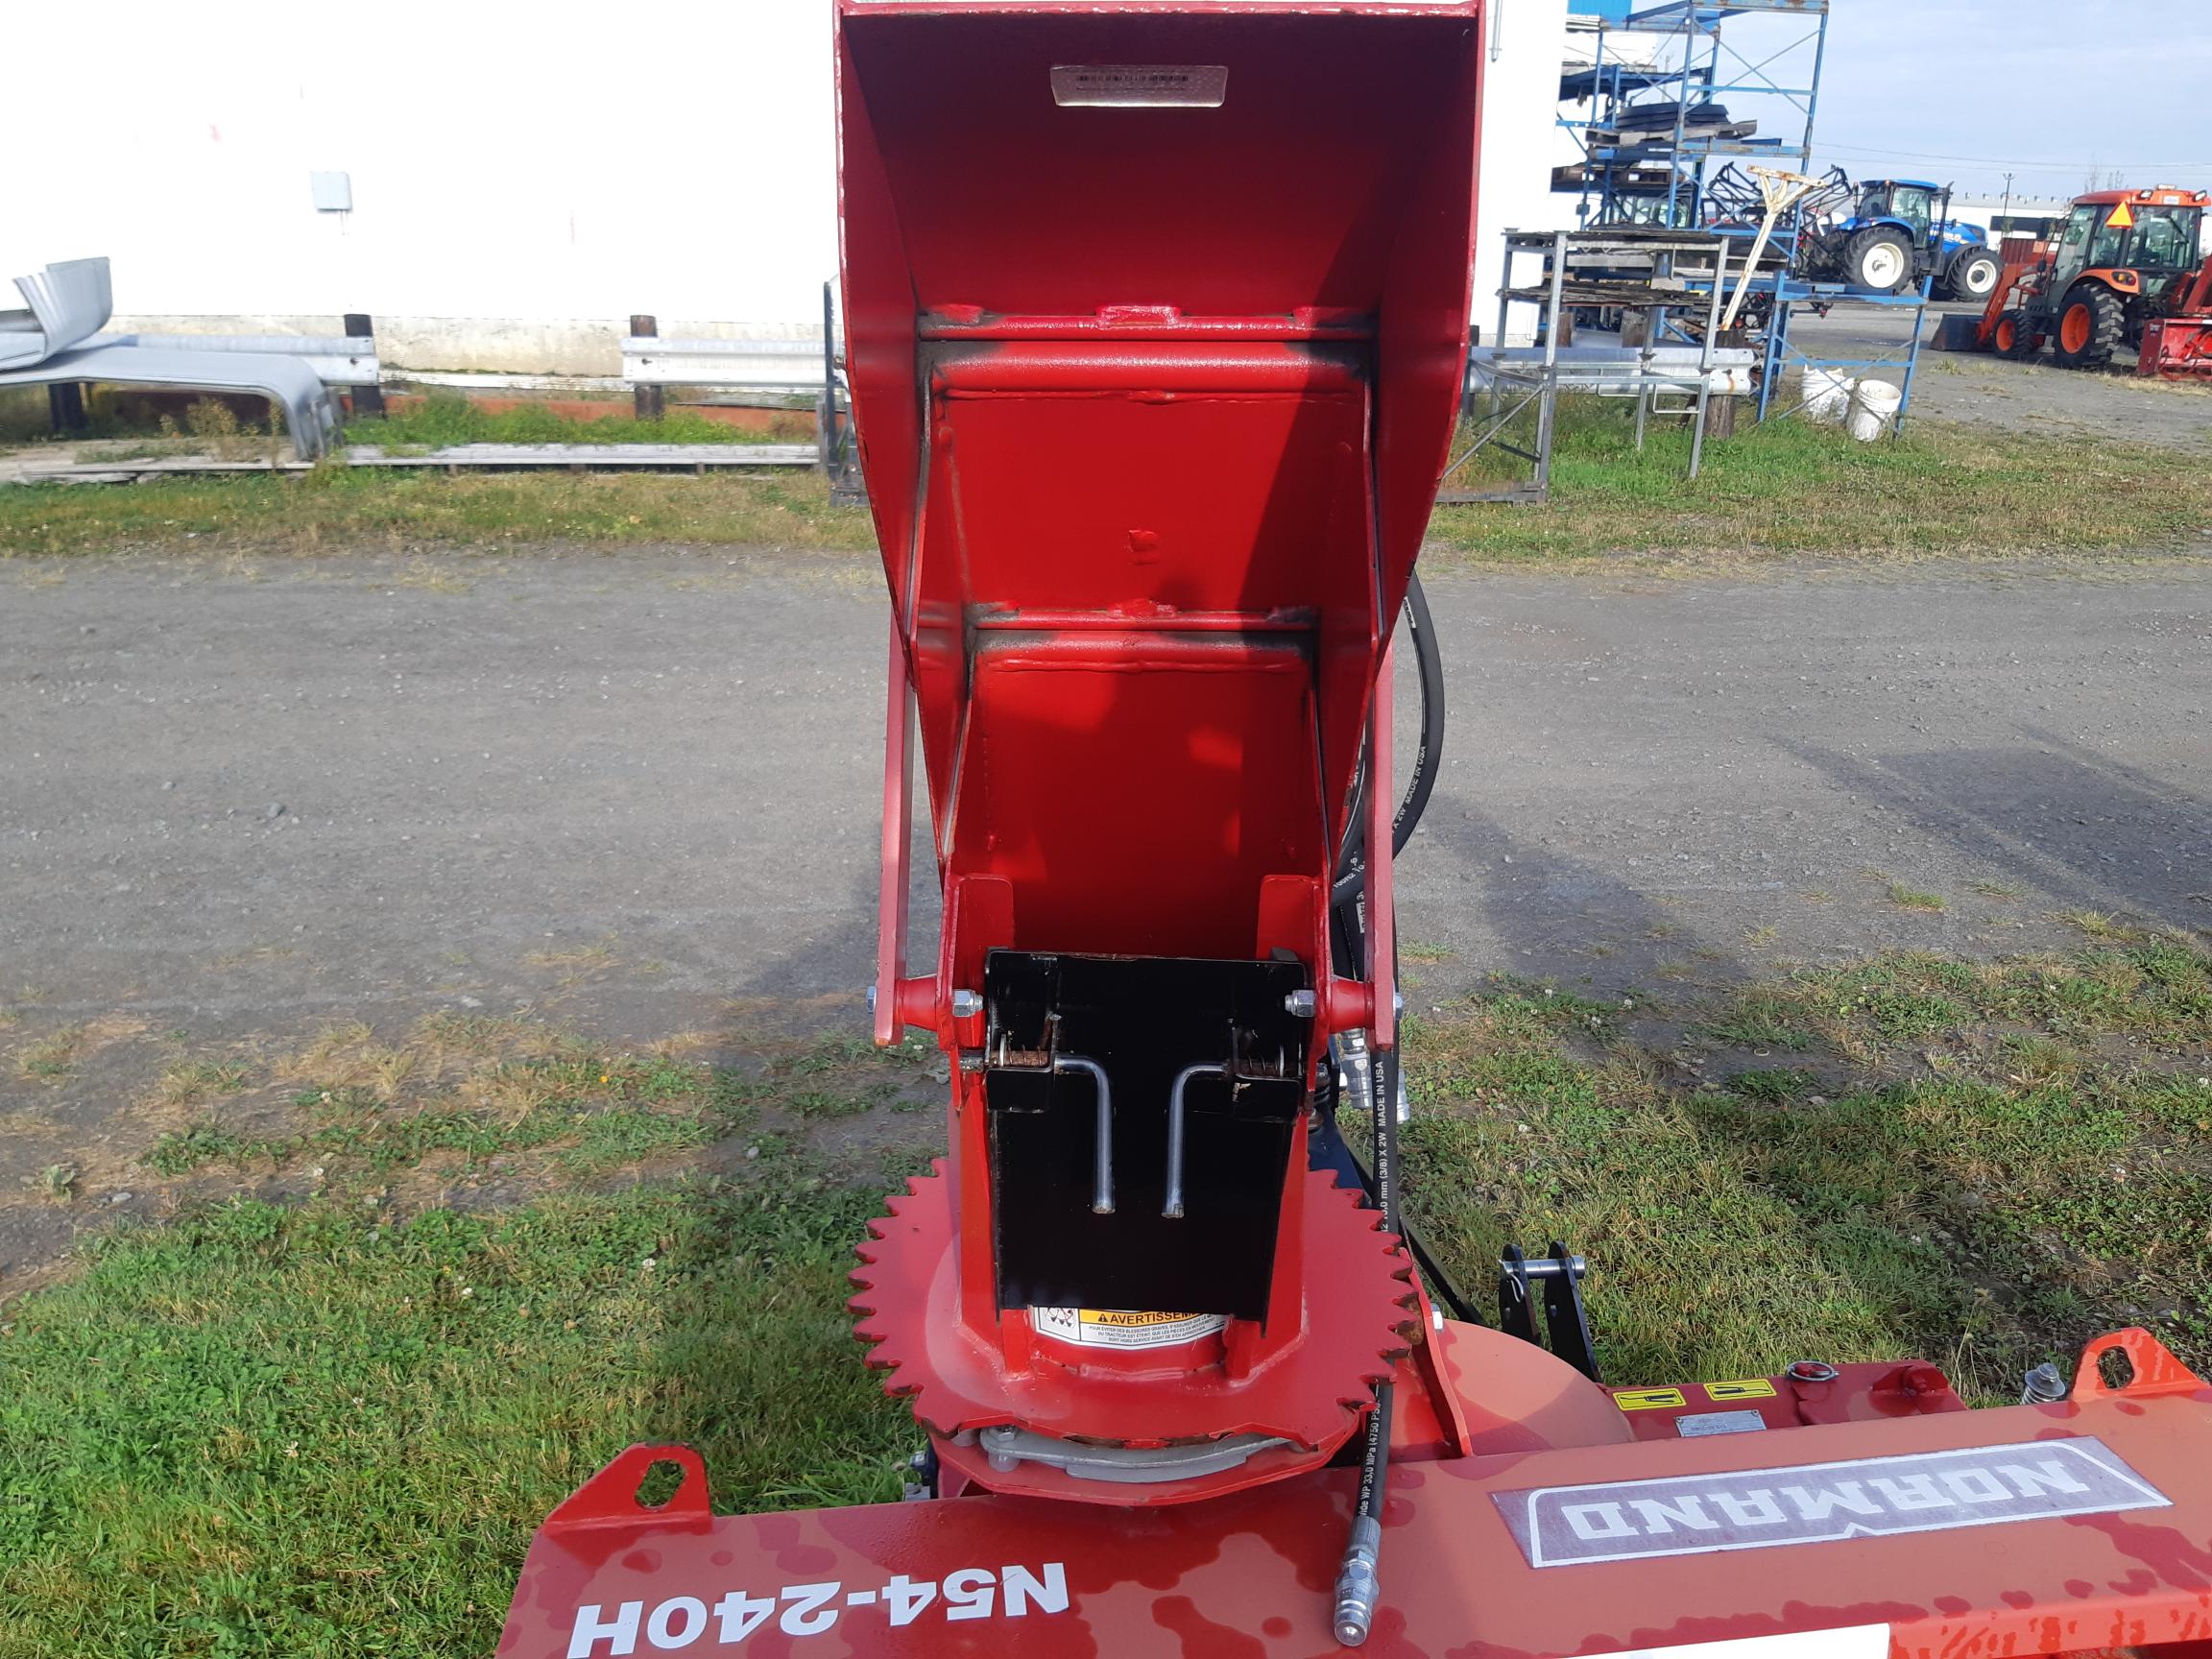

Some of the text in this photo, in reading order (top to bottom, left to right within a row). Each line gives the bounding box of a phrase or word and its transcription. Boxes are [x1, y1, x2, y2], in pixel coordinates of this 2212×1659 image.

[1417, 746, 1426, 765] USA
[1415, 767, 1422, 777] IN
[1405, 778, 1419, 805] MADE
[1375, 1061, 1384, 1083] USA
[1376, 1085, 1385, 1095] IN
[1377, 1097, 1386, 1126] MADE
[1378, 1133, 1387, 1147] 2W
[1379, 1159, 1388, 1179] (3/8)
[1382, 1181, 1388, 1199] mm
[1368, 1423, 1379, 1446] (4750
[1365, 1447, 1376, 1465] MPa
[1363, 1467, 1374, 1484] 33,0
[1360, 1486, 1371, 1501] WP
[1562, 1460, 2090, 1540] NORMAND
[566, 1562, 1070, 1659] N54-240H
